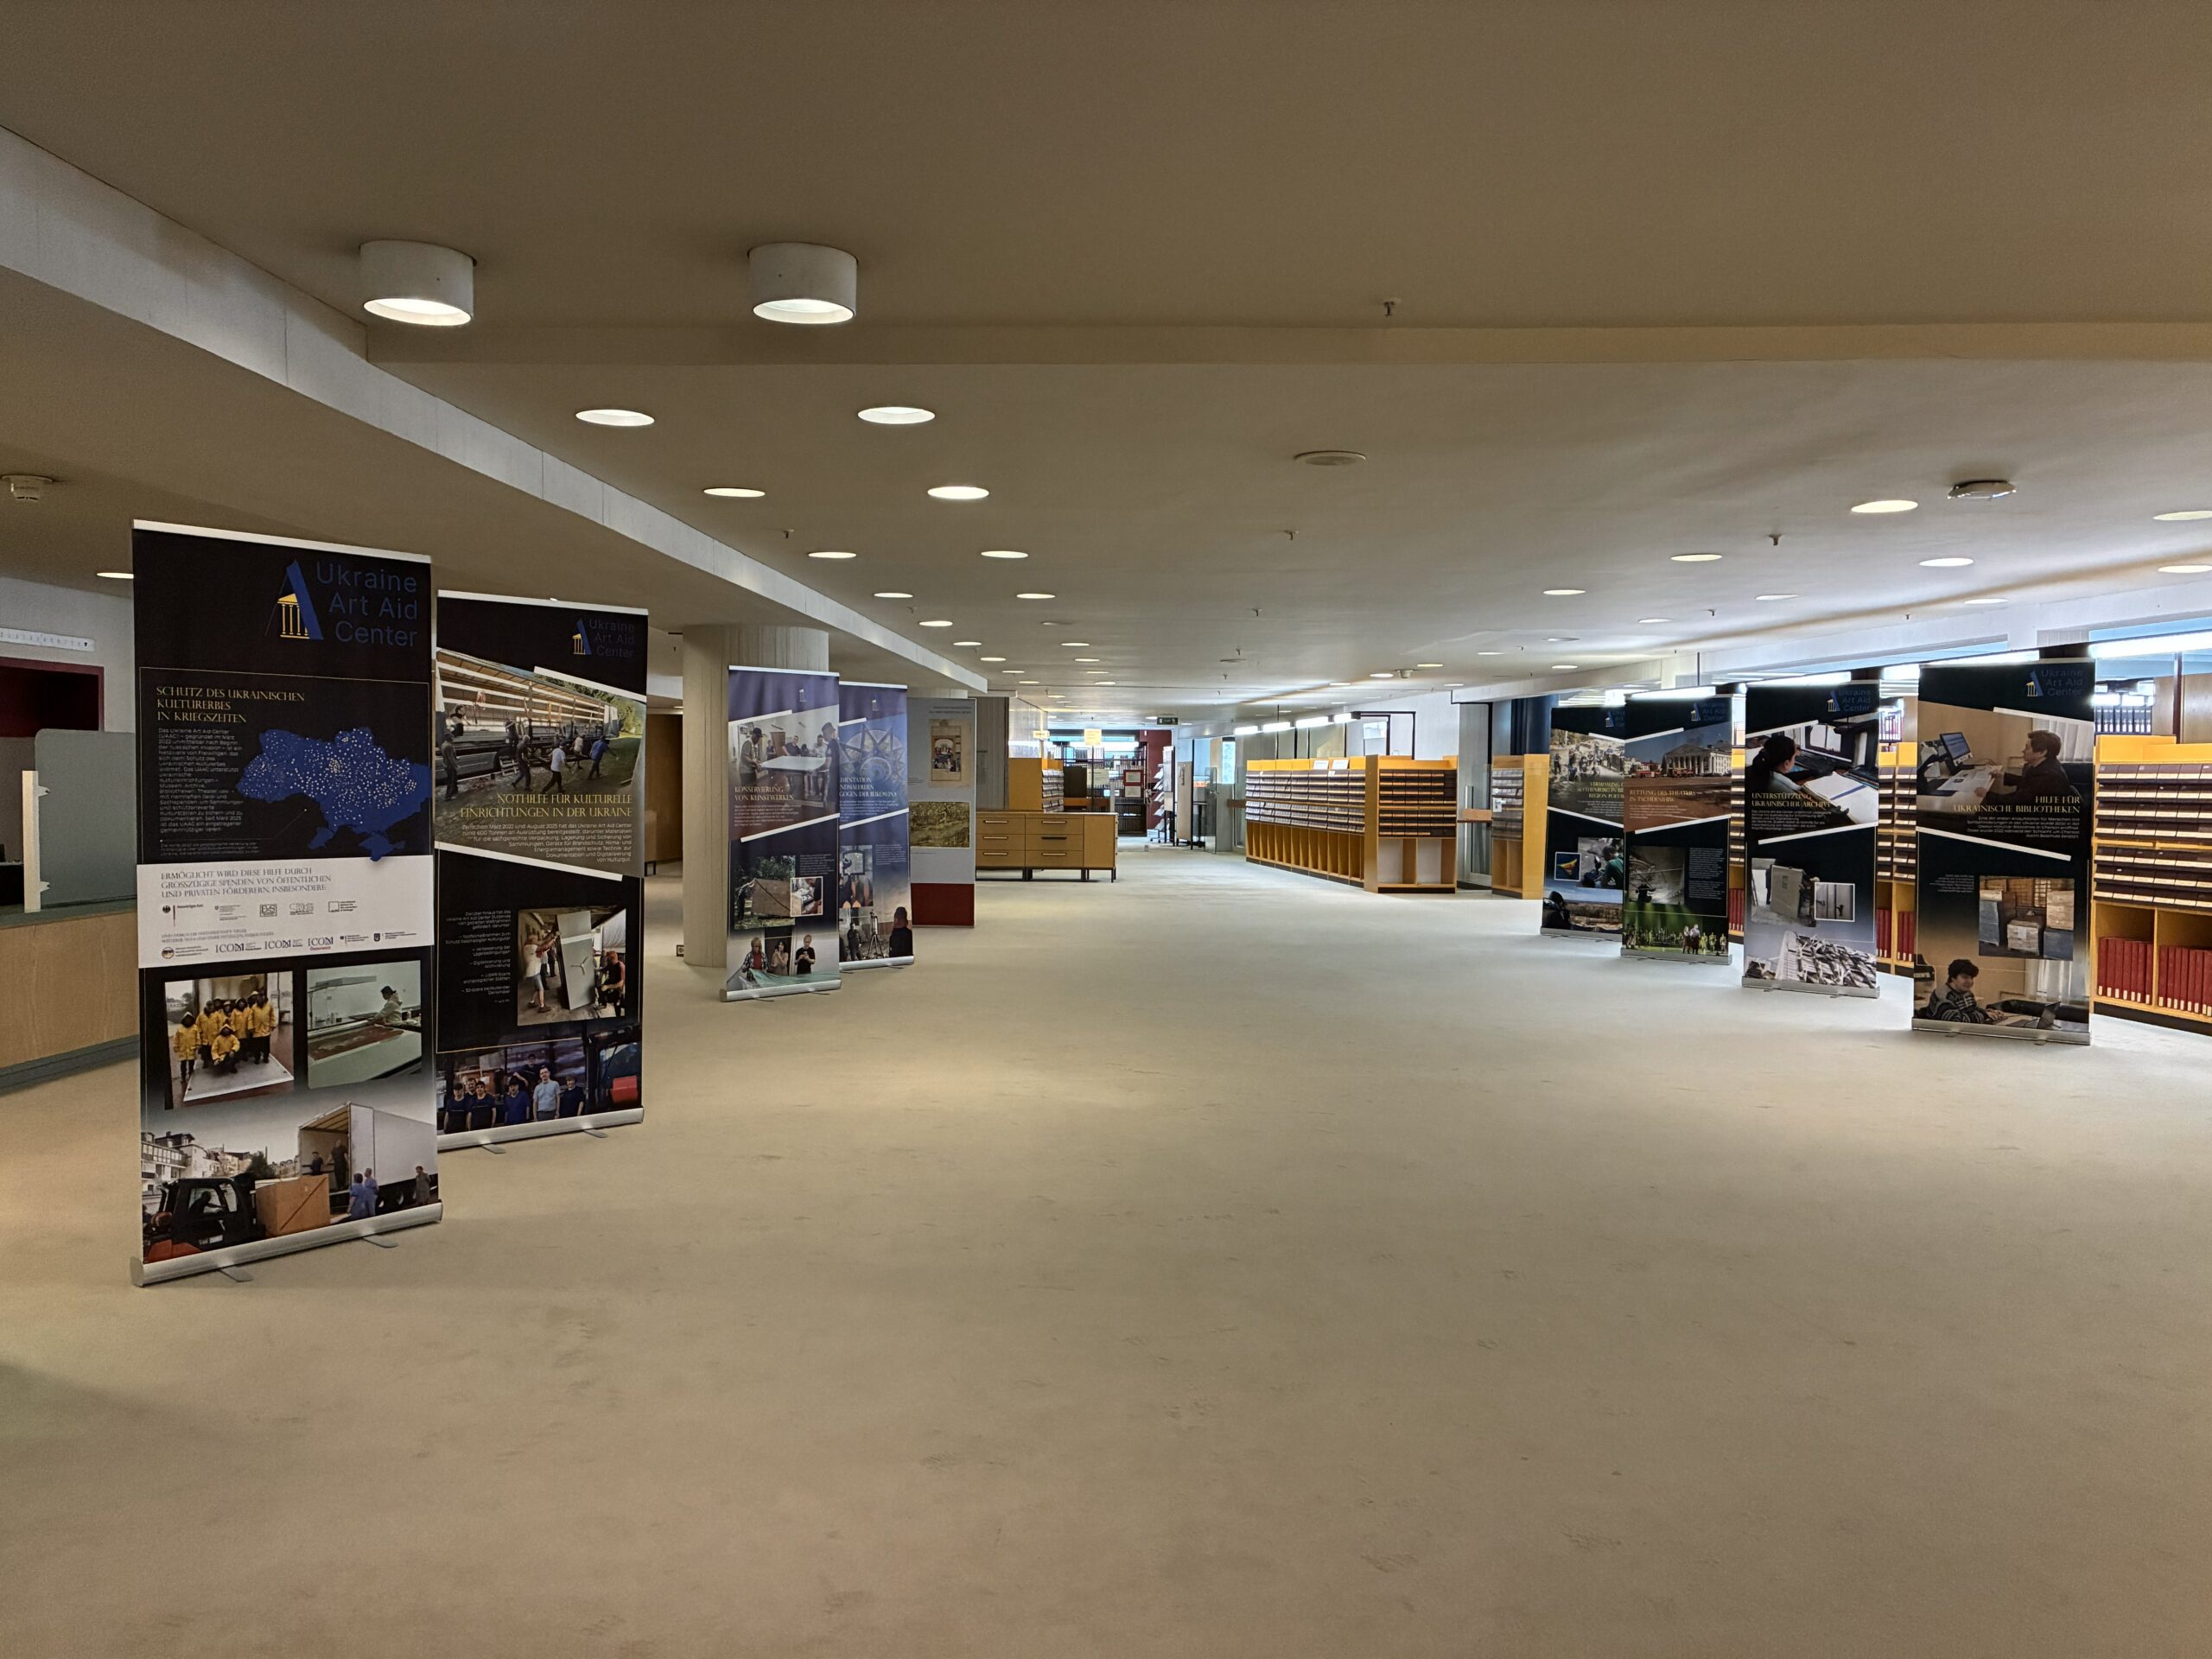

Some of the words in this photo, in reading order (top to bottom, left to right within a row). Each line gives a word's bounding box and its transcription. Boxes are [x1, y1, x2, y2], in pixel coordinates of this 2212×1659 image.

[316, 562, 417, 594] Ukraine
[328, 592, 368, 616] Art
[378, 596, 418, 620] Aid
[589, 618, 636, 633] Ukraine
[334, 620, 418, 647] Center
[594, 632, 612, 644] Art
[616, 634, 636, 645] Aid
[596, 645, 635, 658] Center
[2041, 669, 2083, 677] Ukraine
[2046, 678, 2063, 687] Art
[2065, 677, 2083, 686] Aid
[156, 686, 204, 697] SCHUTZ
[207, 688, 226, 698] DES
[228, 689, 305, 702] UKRAINISCHEN
[2047, 687, 2082, 696] Center
[156, 698, 232, 710] KULTURERBES
[157, 710, 170, 721] IN
[174, 711, 247, 723] KRIEGSZEITEN
[497, 793, 549, 804] NOTHILFE
[551, 793, 571, 804] FÜR
[574, 793, 632, 804] KULTURELLE
[1751, 791, 1812, 800] UNTERSTÜTZUNG
[2035, 795, 2060, 804] HILFE
[2063, 795, 2081, 804] FÜR
[461, 807, 550, 817] EINRICHTUNGEN
[552, 807, 563, 817] IN
[567, 807, 586, 817] DER
[589, 807, 632, 817] UKRAINE
[2015, 804, 2080, 813] BIBLIOTHEKEN
[161, 870, 214, 880] ERMÖGLICHT
[263, 868, 283, 876] HILFE
[285, 867, 313, 875] DURCH
[161, 879, 217, 889] GROSSZÜGIGE
[219, 878, 254, 887] SPENDEN
[276, 874, 332, 884] ÖFFENTLICHEN
[184, 888, 222, 897] PRIVATEN
[264, 939, 291, 950] ICOM
[308, 937, 334, 946] ICOM
[215, 943, 245, 953] ICOM
